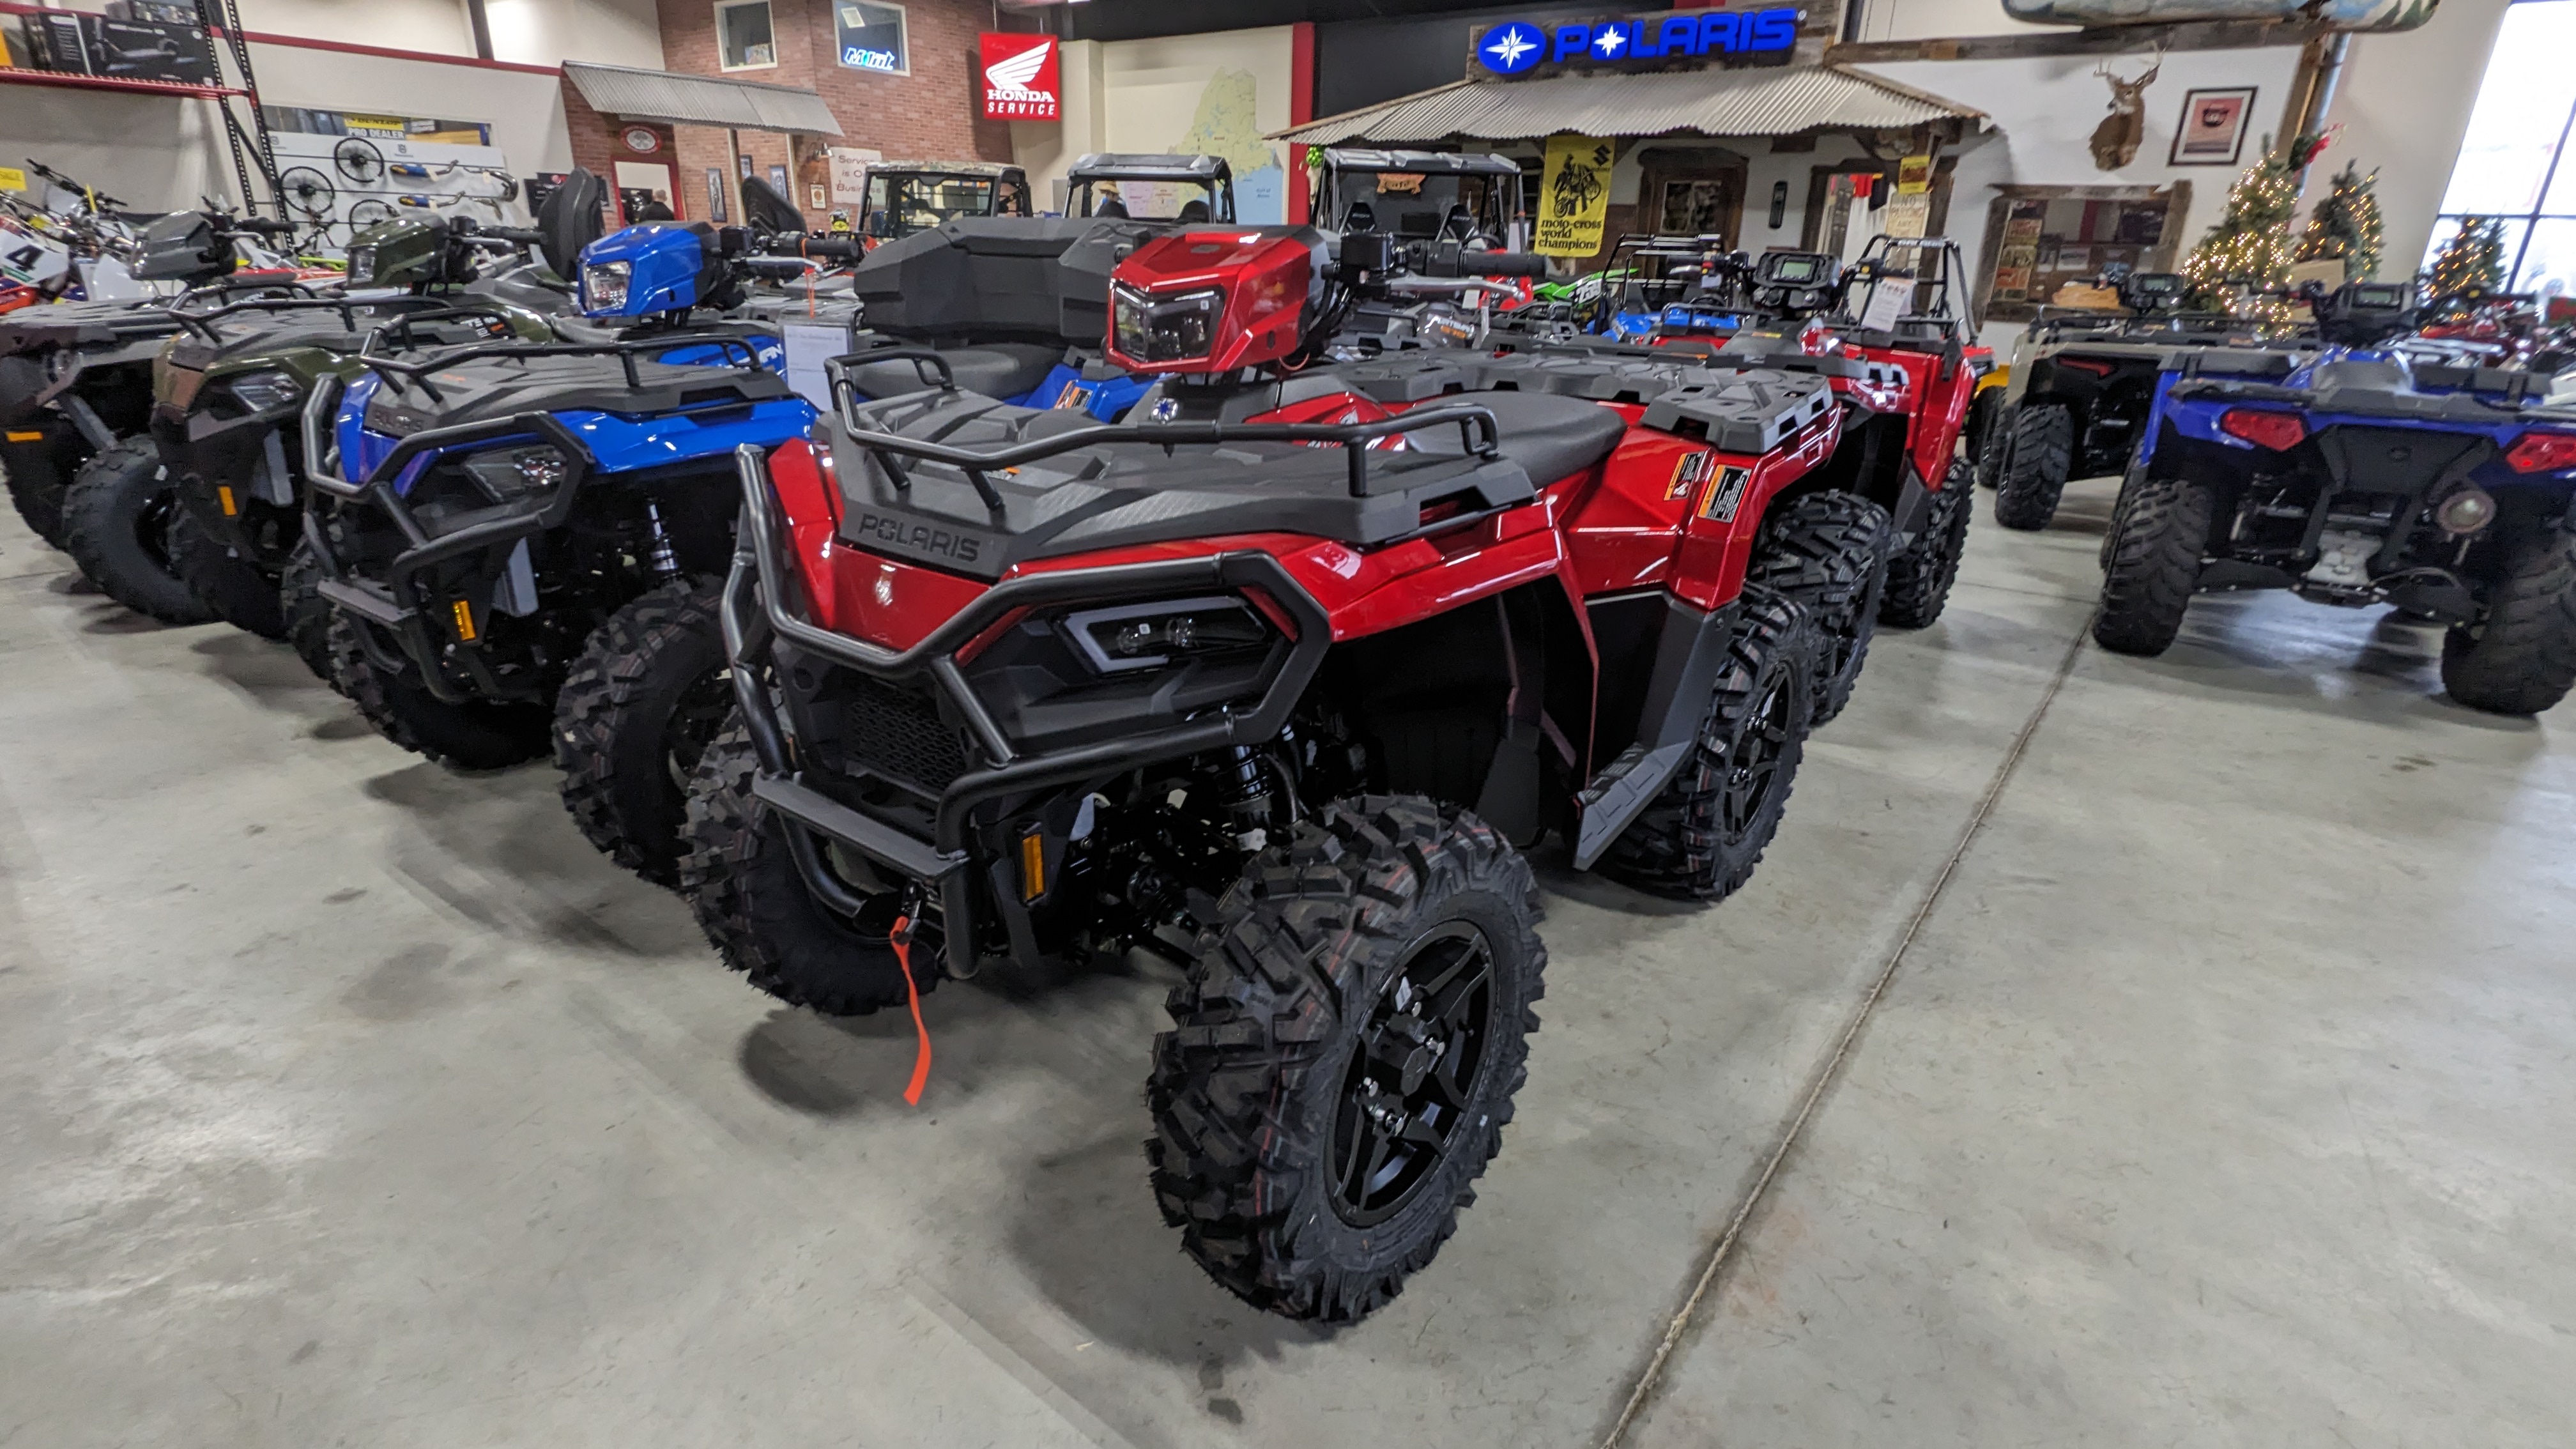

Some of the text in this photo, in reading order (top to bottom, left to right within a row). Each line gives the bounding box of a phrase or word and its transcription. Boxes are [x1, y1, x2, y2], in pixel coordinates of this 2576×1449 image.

[1554, 9, 1797, 63] POLARIS
[987, 89, 1055, 102] HONDA
[988, 102, 1055, 115] SERVICE
[369, 129, 404, 139] DEALER
[1540, 218, 1602, 230] moto-cross
[1540, 228, 1572, 239] world
[1538, 236, 1597, 251] champions
[6, 245, 45, 272] 4
[858, 513, 981, 562] POLARIS
